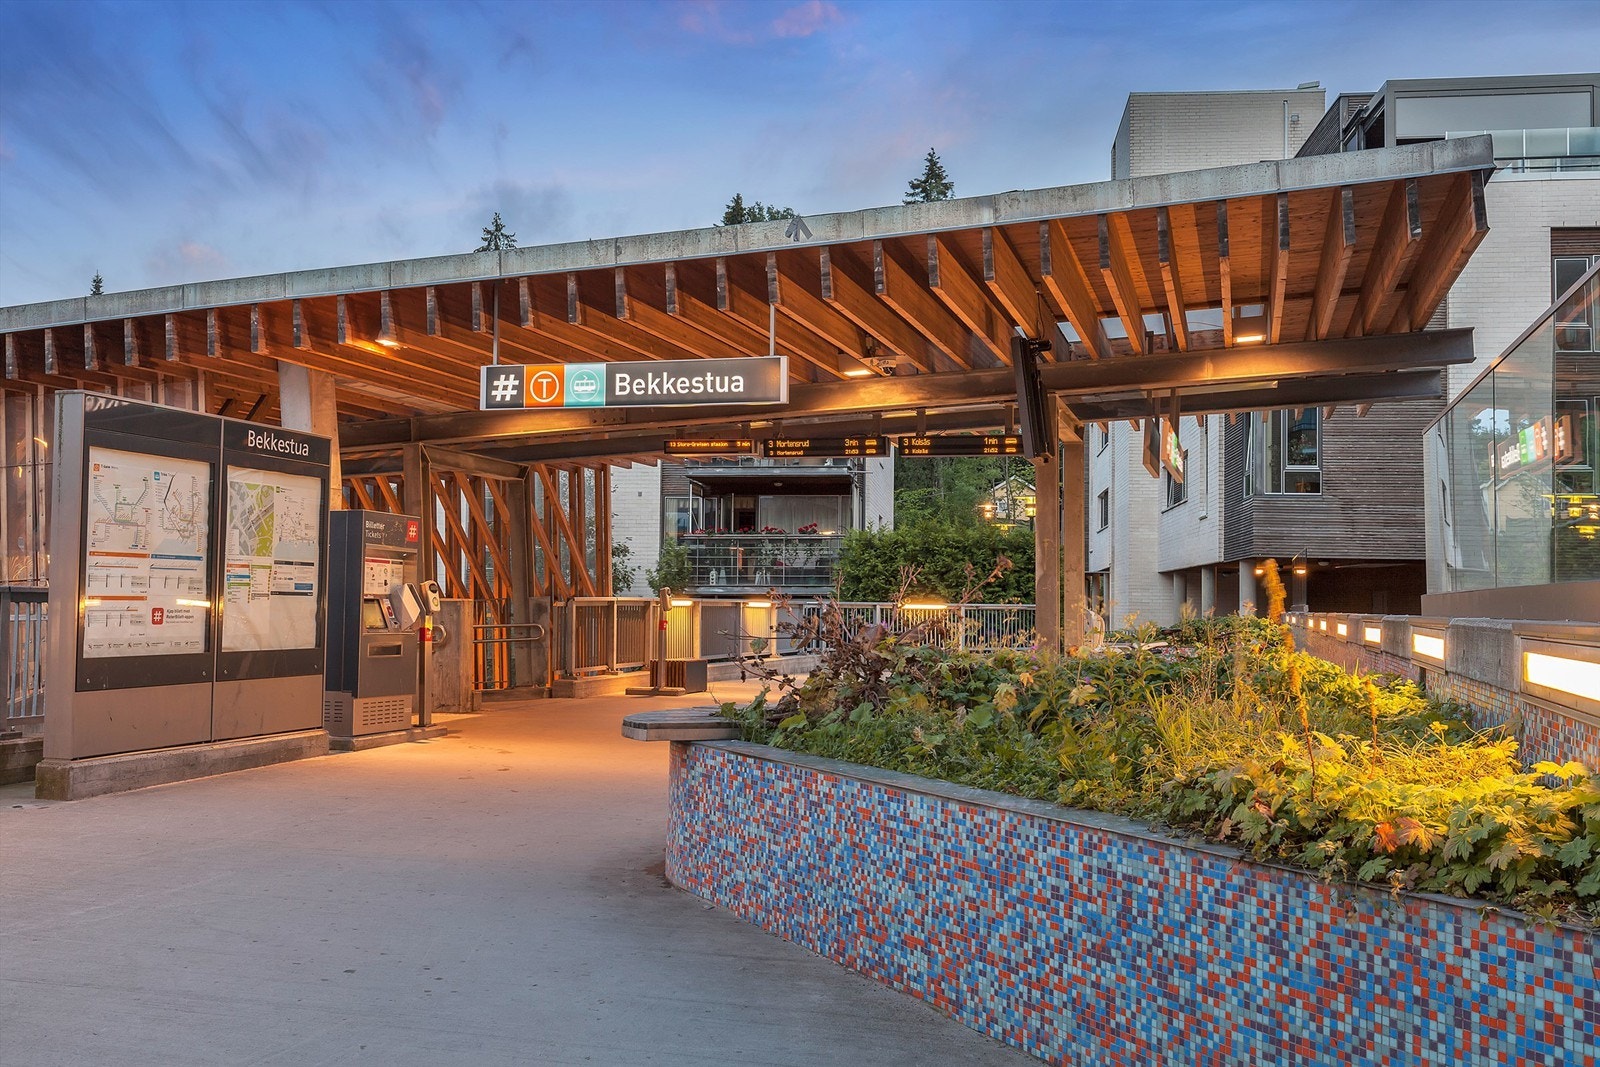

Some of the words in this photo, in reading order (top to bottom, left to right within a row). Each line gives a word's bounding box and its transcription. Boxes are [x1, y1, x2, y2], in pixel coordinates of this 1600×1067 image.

[614, 371, 745, 396] Bekkestua
[247, 429, 310, 457] Bekkestua
[768, 440, 774, 448] 3
[776, 440, 810, 448] Mortensrud
[903, 438, 909, 446] 3
[365, 520, 386, 530] Billetter
[365, 529, 382, 539] Tickets
